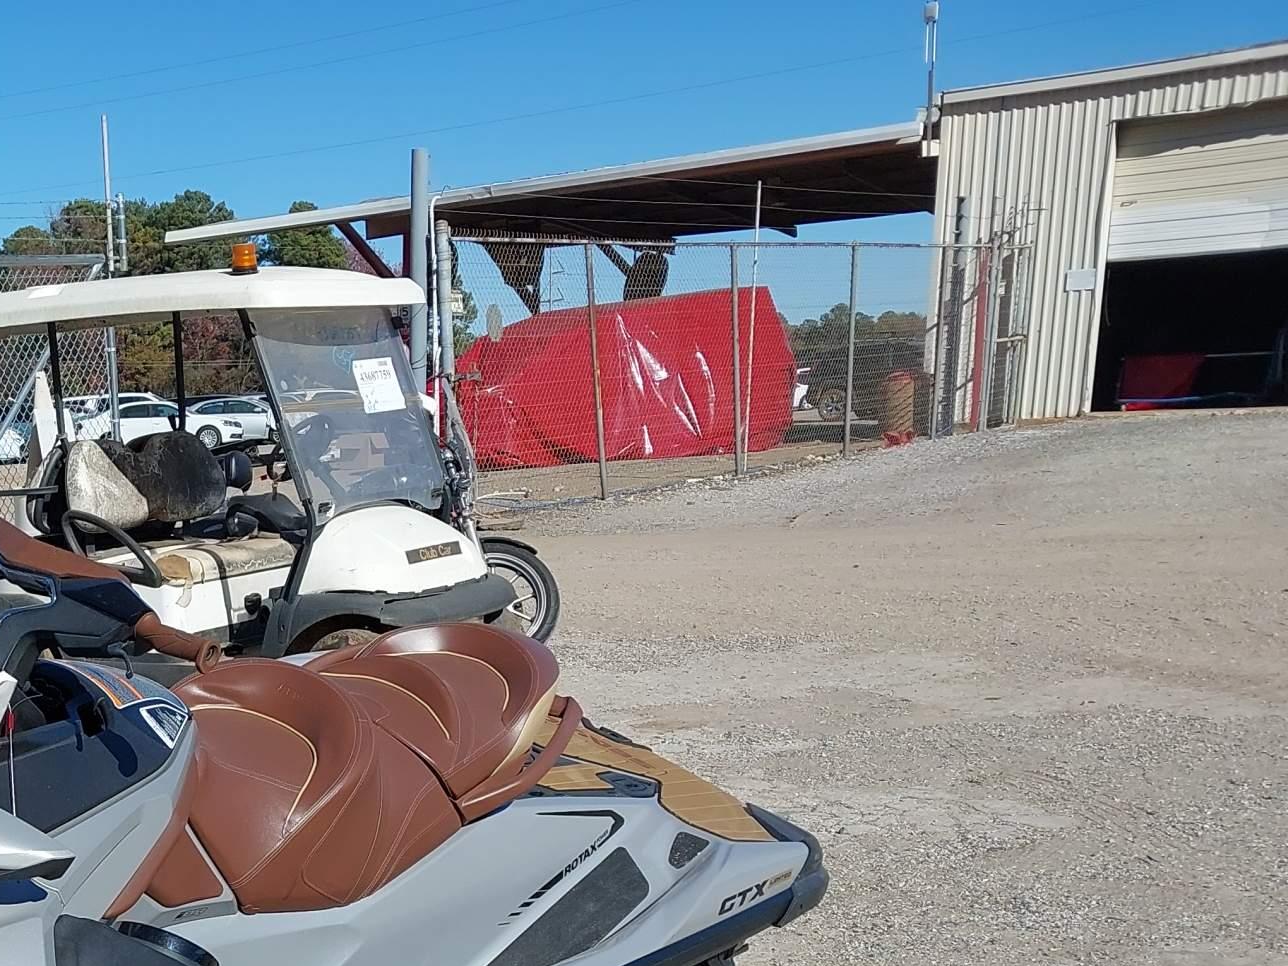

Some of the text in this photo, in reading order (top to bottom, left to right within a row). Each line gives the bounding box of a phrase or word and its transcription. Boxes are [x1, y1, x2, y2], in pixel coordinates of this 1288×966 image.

[419, 545, 452, 560] Club Car
[564, 840, 598, 877] ROTAX
[718, 879, 769, 916] GTX
